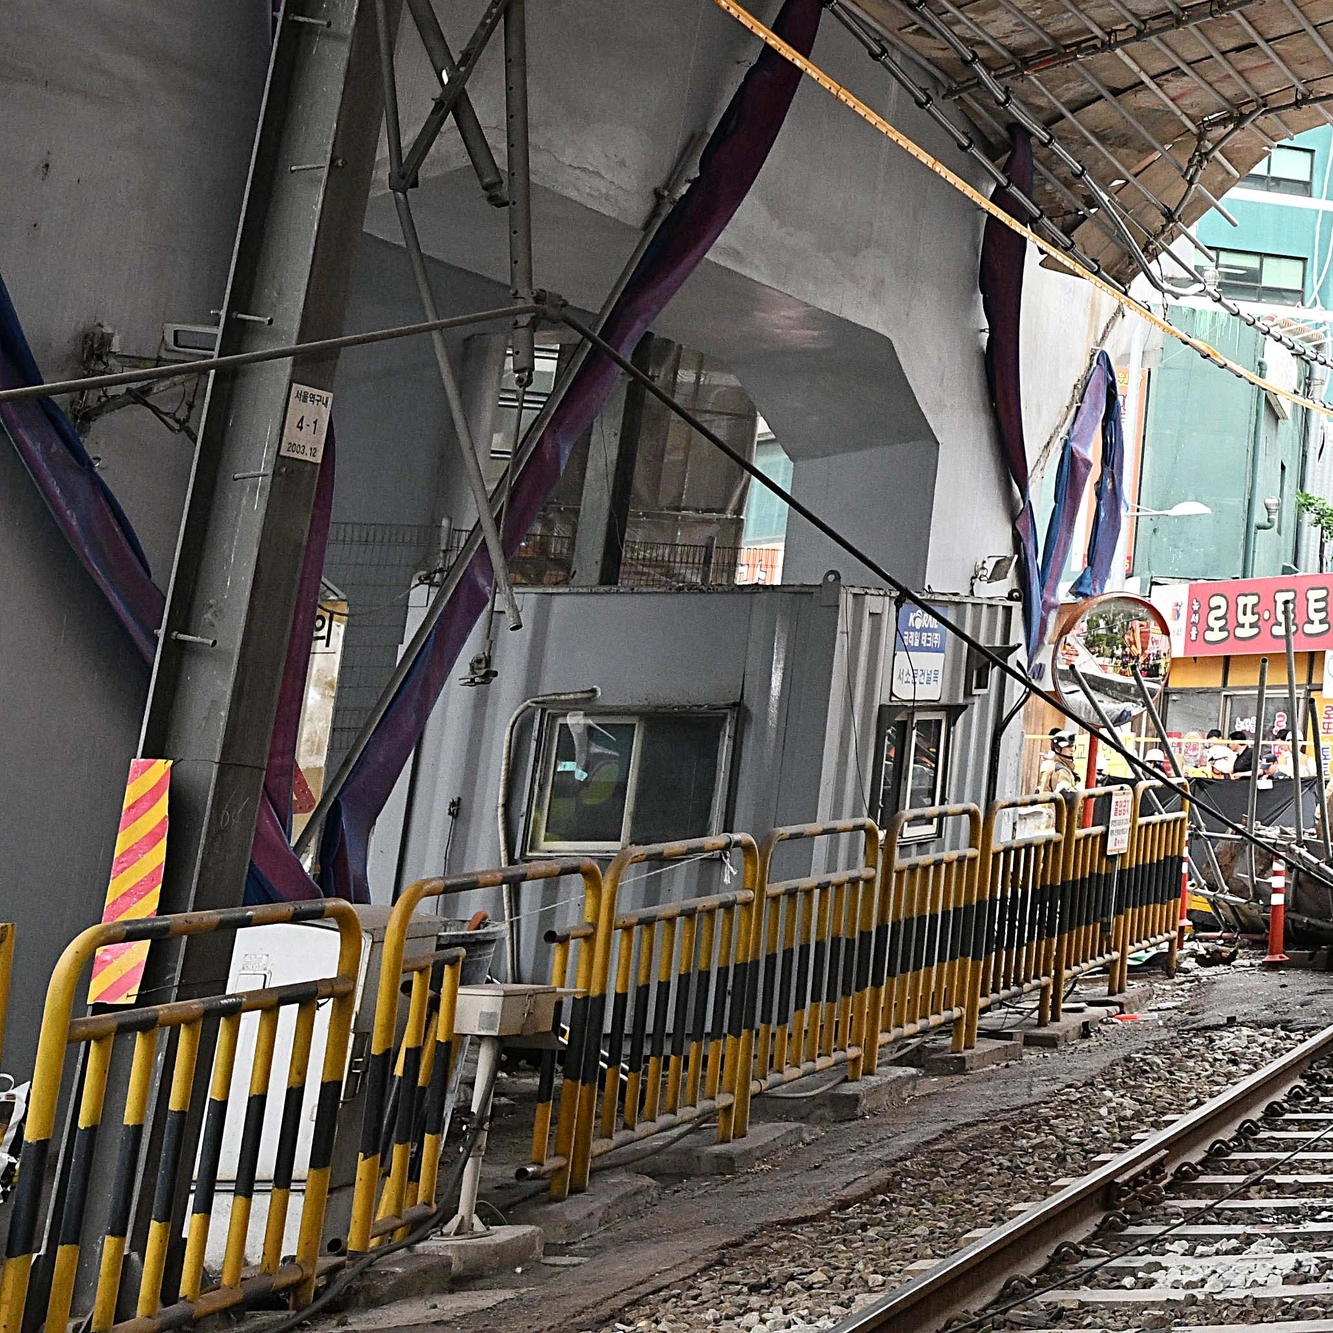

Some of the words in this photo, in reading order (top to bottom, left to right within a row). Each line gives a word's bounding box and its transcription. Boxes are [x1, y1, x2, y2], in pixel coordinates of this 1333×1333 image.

[295, 389, 329, 408] 서울역구내
[296, 415, 318, 435] 4-1
[286, 442, 318, 457] 2003.12
[908, 609, 939, 630] KORAIL
[1190, 597, 1201, 642] 뉴서울
[903, 630, 921, 647] 코레일
[921, 632, 940, 649] 테크(주)
[897, 668, 940, 685] 서소문건널목
